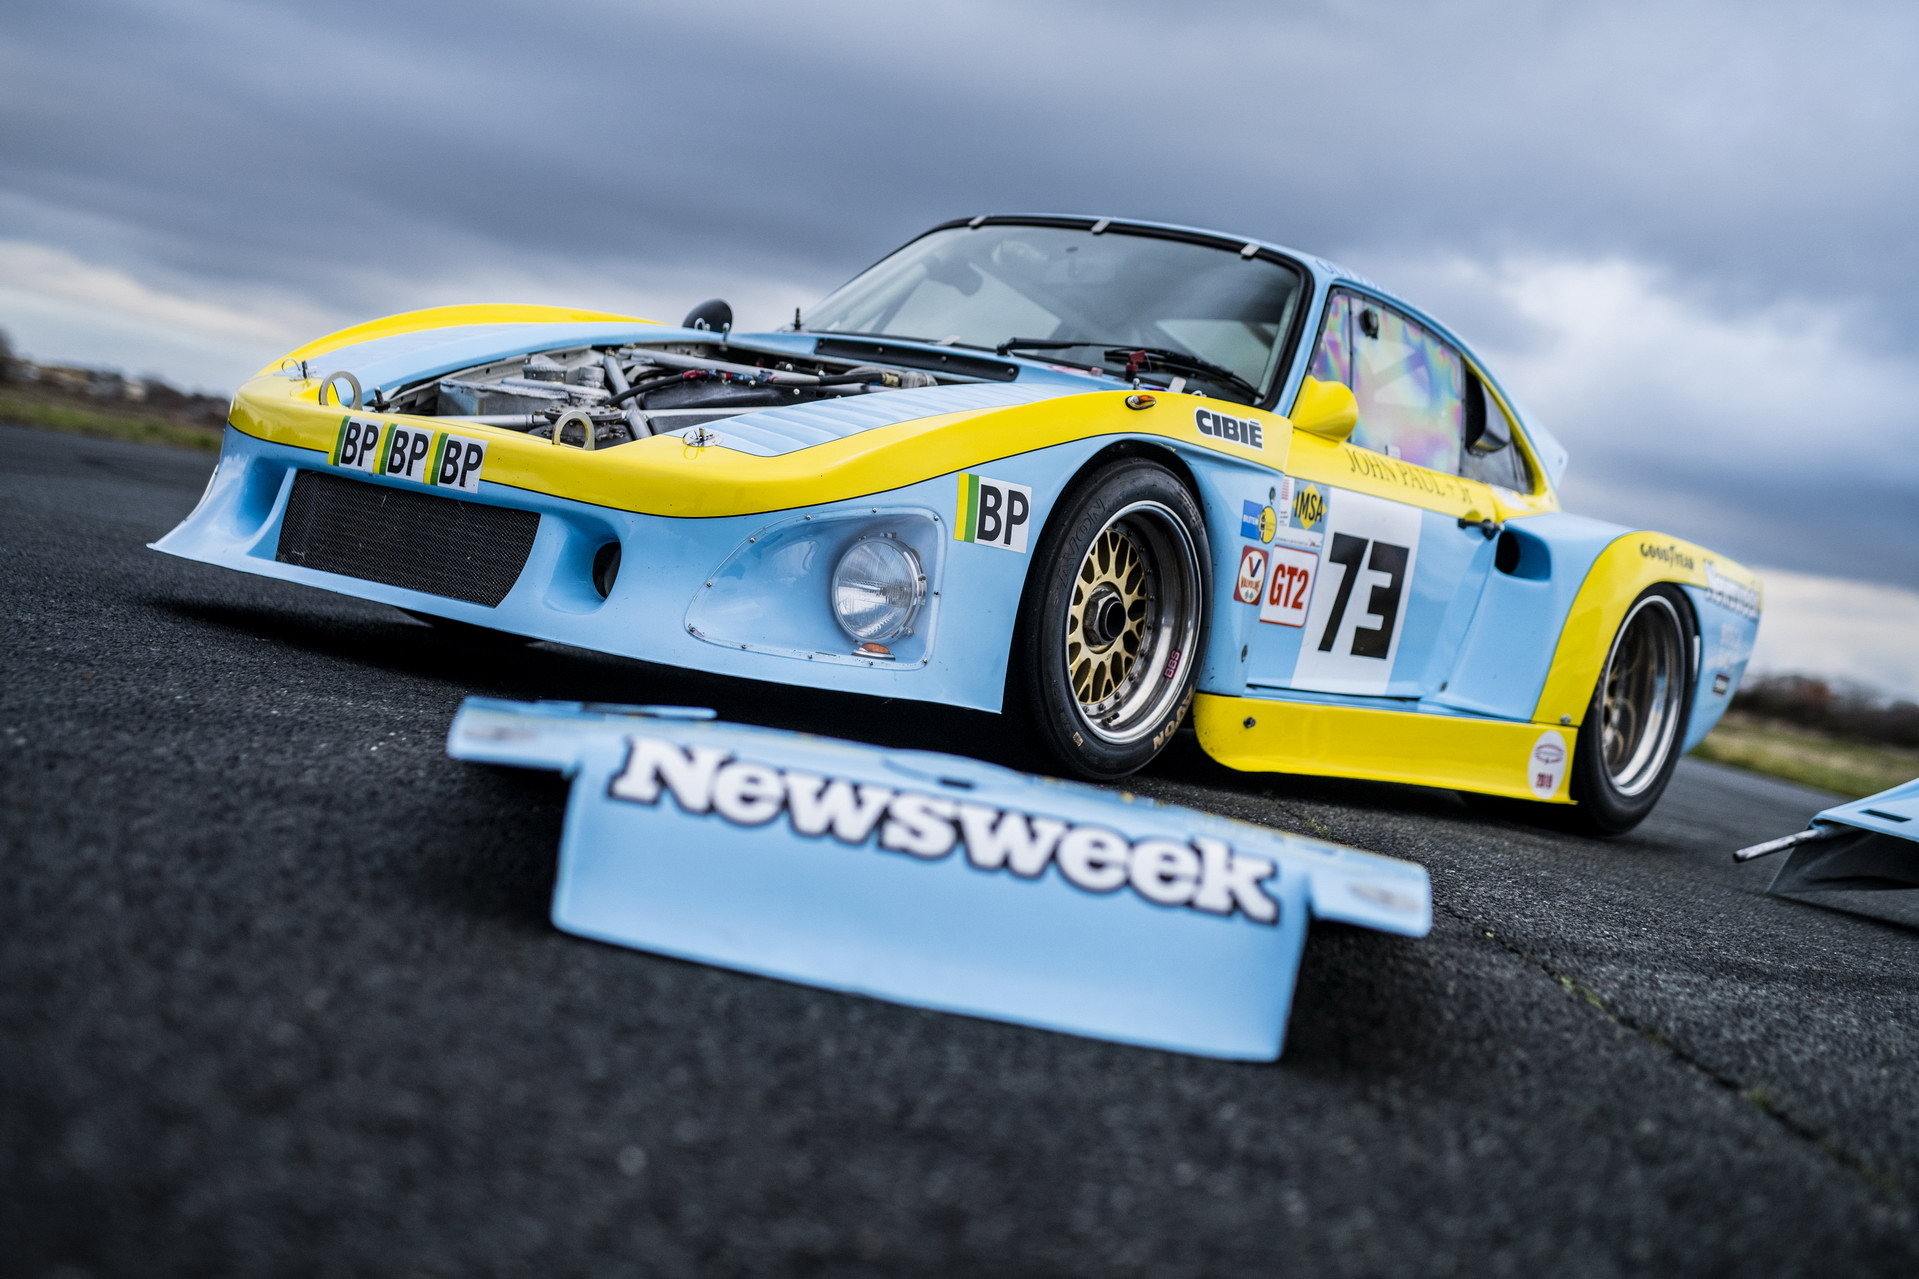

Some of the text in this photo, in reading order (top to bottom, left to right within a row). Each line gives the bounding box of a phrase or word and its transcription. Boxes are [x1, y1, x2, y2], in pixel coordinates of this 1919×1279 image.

[340, 421, 379, 467] BP
[387, 429, 429, 477] BP
[438, 439, 483, 488] BP
[1344, 446, 1397, 482] JOHN
[1396, 462, 1446, 497] PAUL
[976, 483, 1030, 546] BP
[1294, 490, 1323, 523] IMSA
[1268, 563, 1310, 610] GT2
[1317, 531, 1410, 660] 73
[1164, 650, 1180, 678] BBS
[610, 735, 1281, 925] Newsweek
